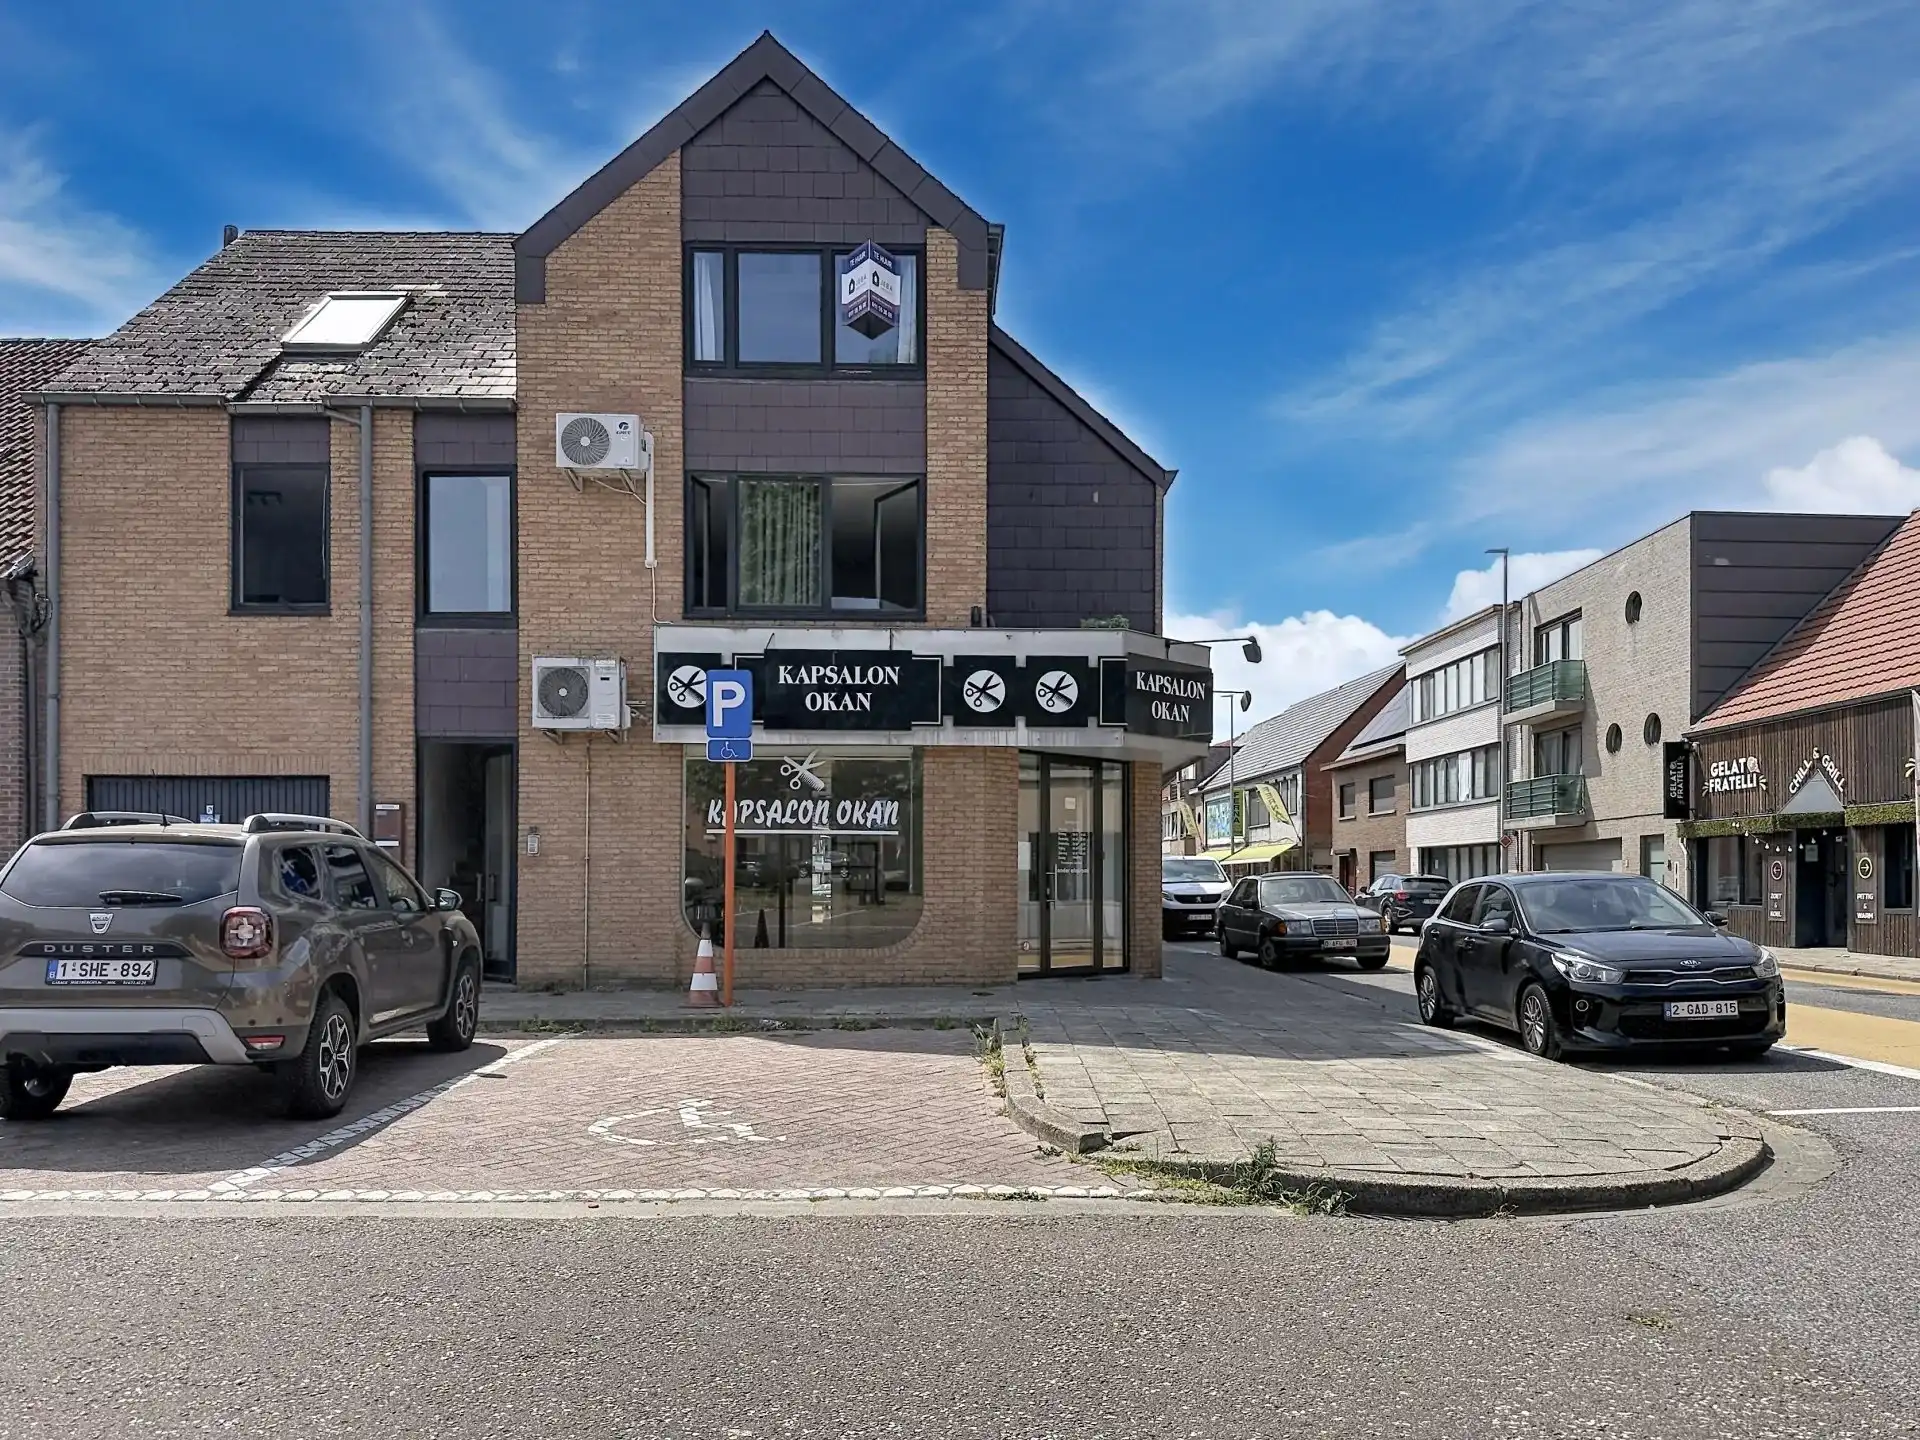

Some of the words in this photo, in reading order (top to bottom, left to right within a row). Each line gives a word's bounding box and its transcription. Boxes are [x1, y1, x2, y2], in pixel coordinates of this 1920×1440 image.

[778, 665, 900, 686] KAPSALON
[1136, 671, 1206, 700] KAPSALON
[712, 680, 746, 727] P
[804, 692, 873, 712] OKAN
[1151, 700, 1190, 723] OKAN
[1788, 759, 1813, 794] CHILL
[1812, 747, 1820, 759] &
[1821, 754, 1846, 793] GRILL
[1708, 773, 1757, 793] FRATELLI
[836, 799, 900, 829] OKAN
[43, 944, 155, 953] DUSTER
[60, 962, 152, 978] 1-SHE-894
[1671, 1002, 1737, 1016] 2-GAD-815
